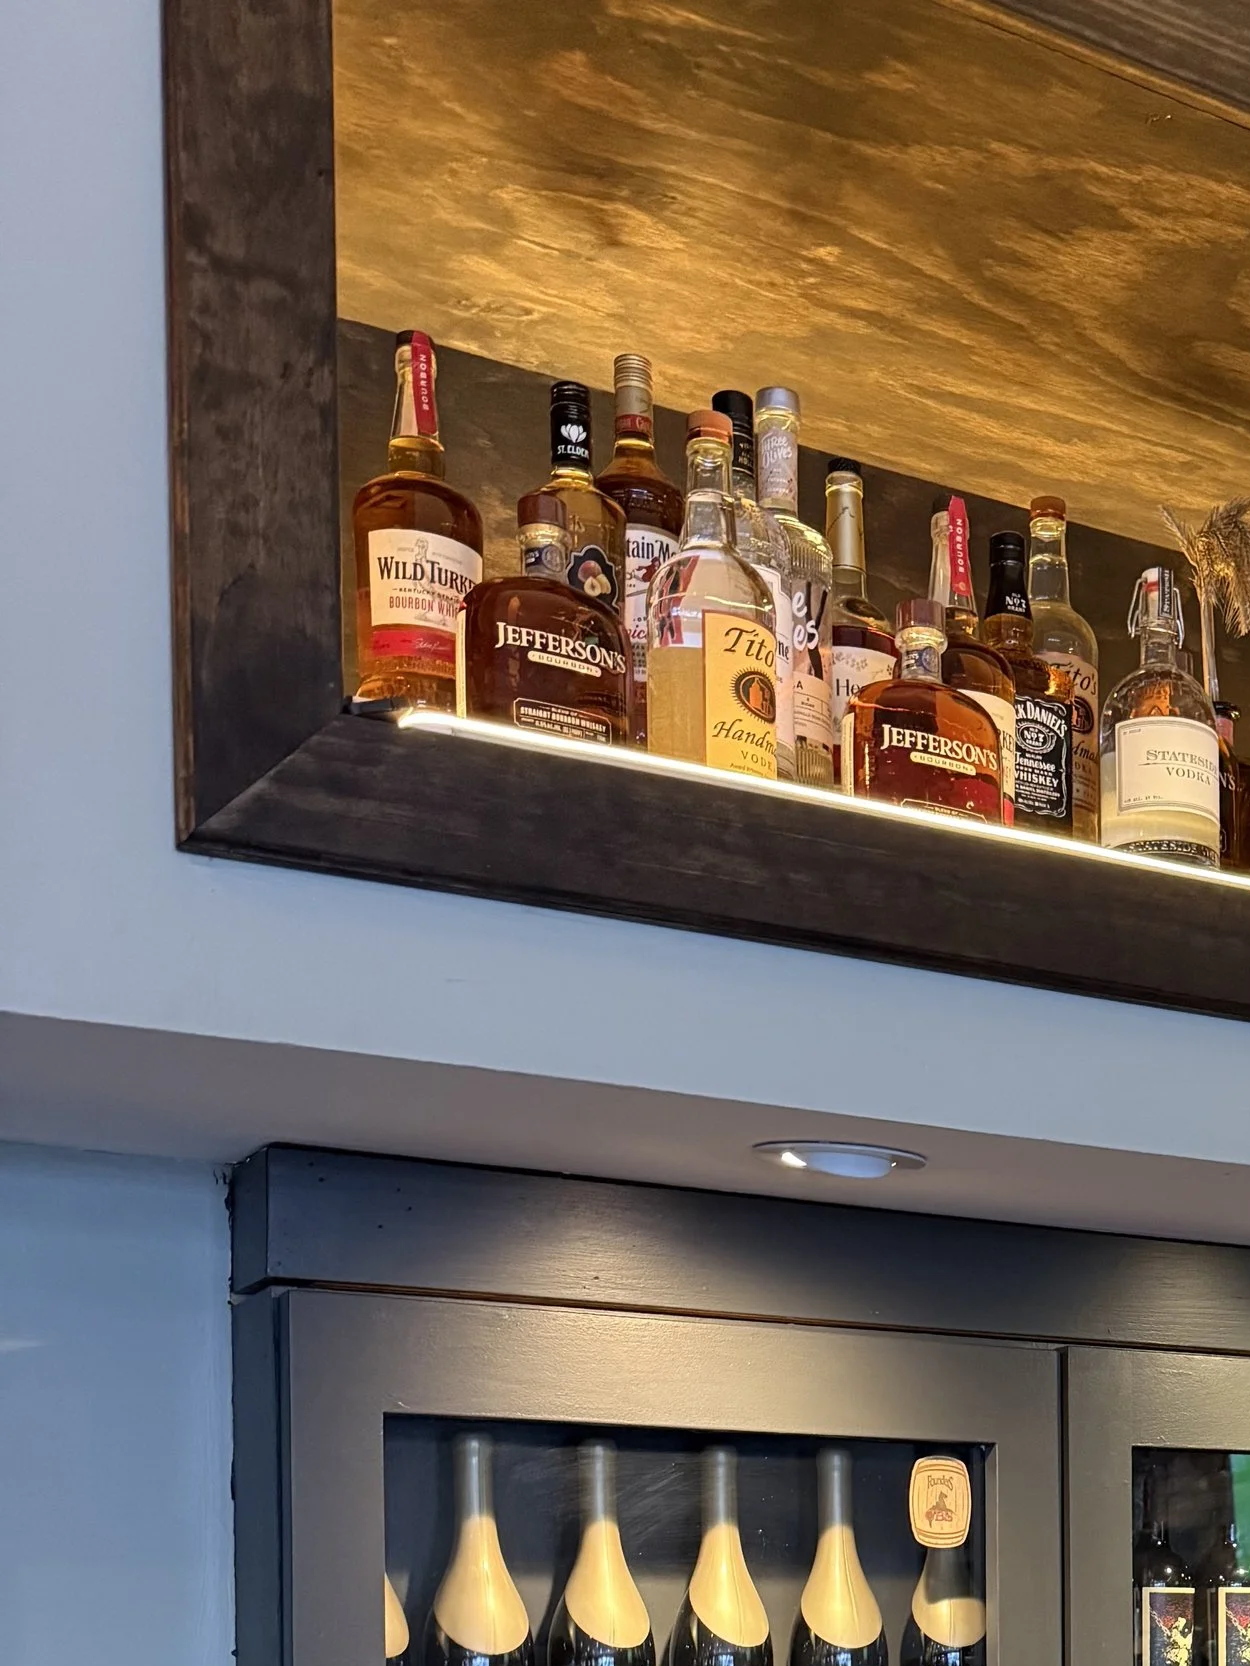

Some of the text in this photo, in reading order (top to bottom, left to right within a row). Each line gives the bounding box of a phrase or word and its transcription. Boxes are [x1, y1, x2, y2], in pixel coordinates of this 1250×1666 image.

[956, 518, 965, 573] BOURBON
[377, 556, 425, 581] WILD
[389, 596, 434, 612] BOURBON
[495, 621, 626, 674] JEFFERSON'S
[538, 654, 593, 672] BOURBON
[880, 724, 998, 770] JEFFERSON'S
[919, 756, 969, 771] BOURBON
[1166, 767, 1211, 786] VODKA
